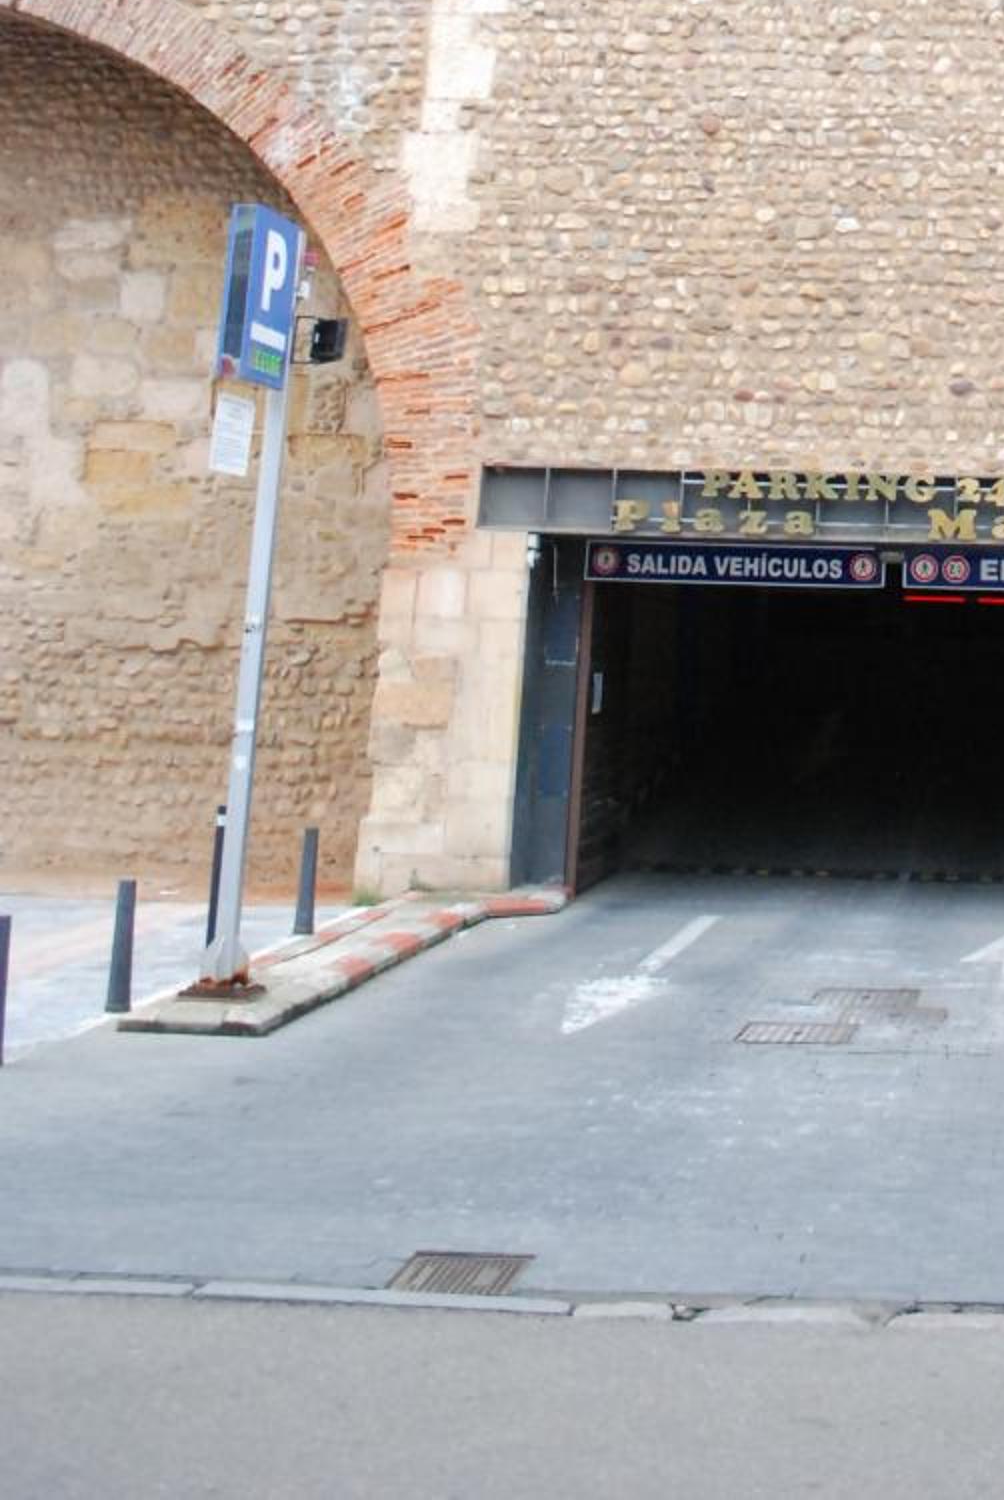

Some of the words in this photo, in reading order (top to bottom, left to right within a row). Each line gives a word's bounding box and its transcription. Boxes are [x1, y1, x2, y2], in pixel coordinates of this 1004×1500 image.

[260, 229, 288, 312] P
[701, 468, 937, 503] PARKING
[613, 499, 815, 536] Plaza
[627, 553, 708, 576] SALIDA
[714, 552, 843, 580] VEHÍCULOS
